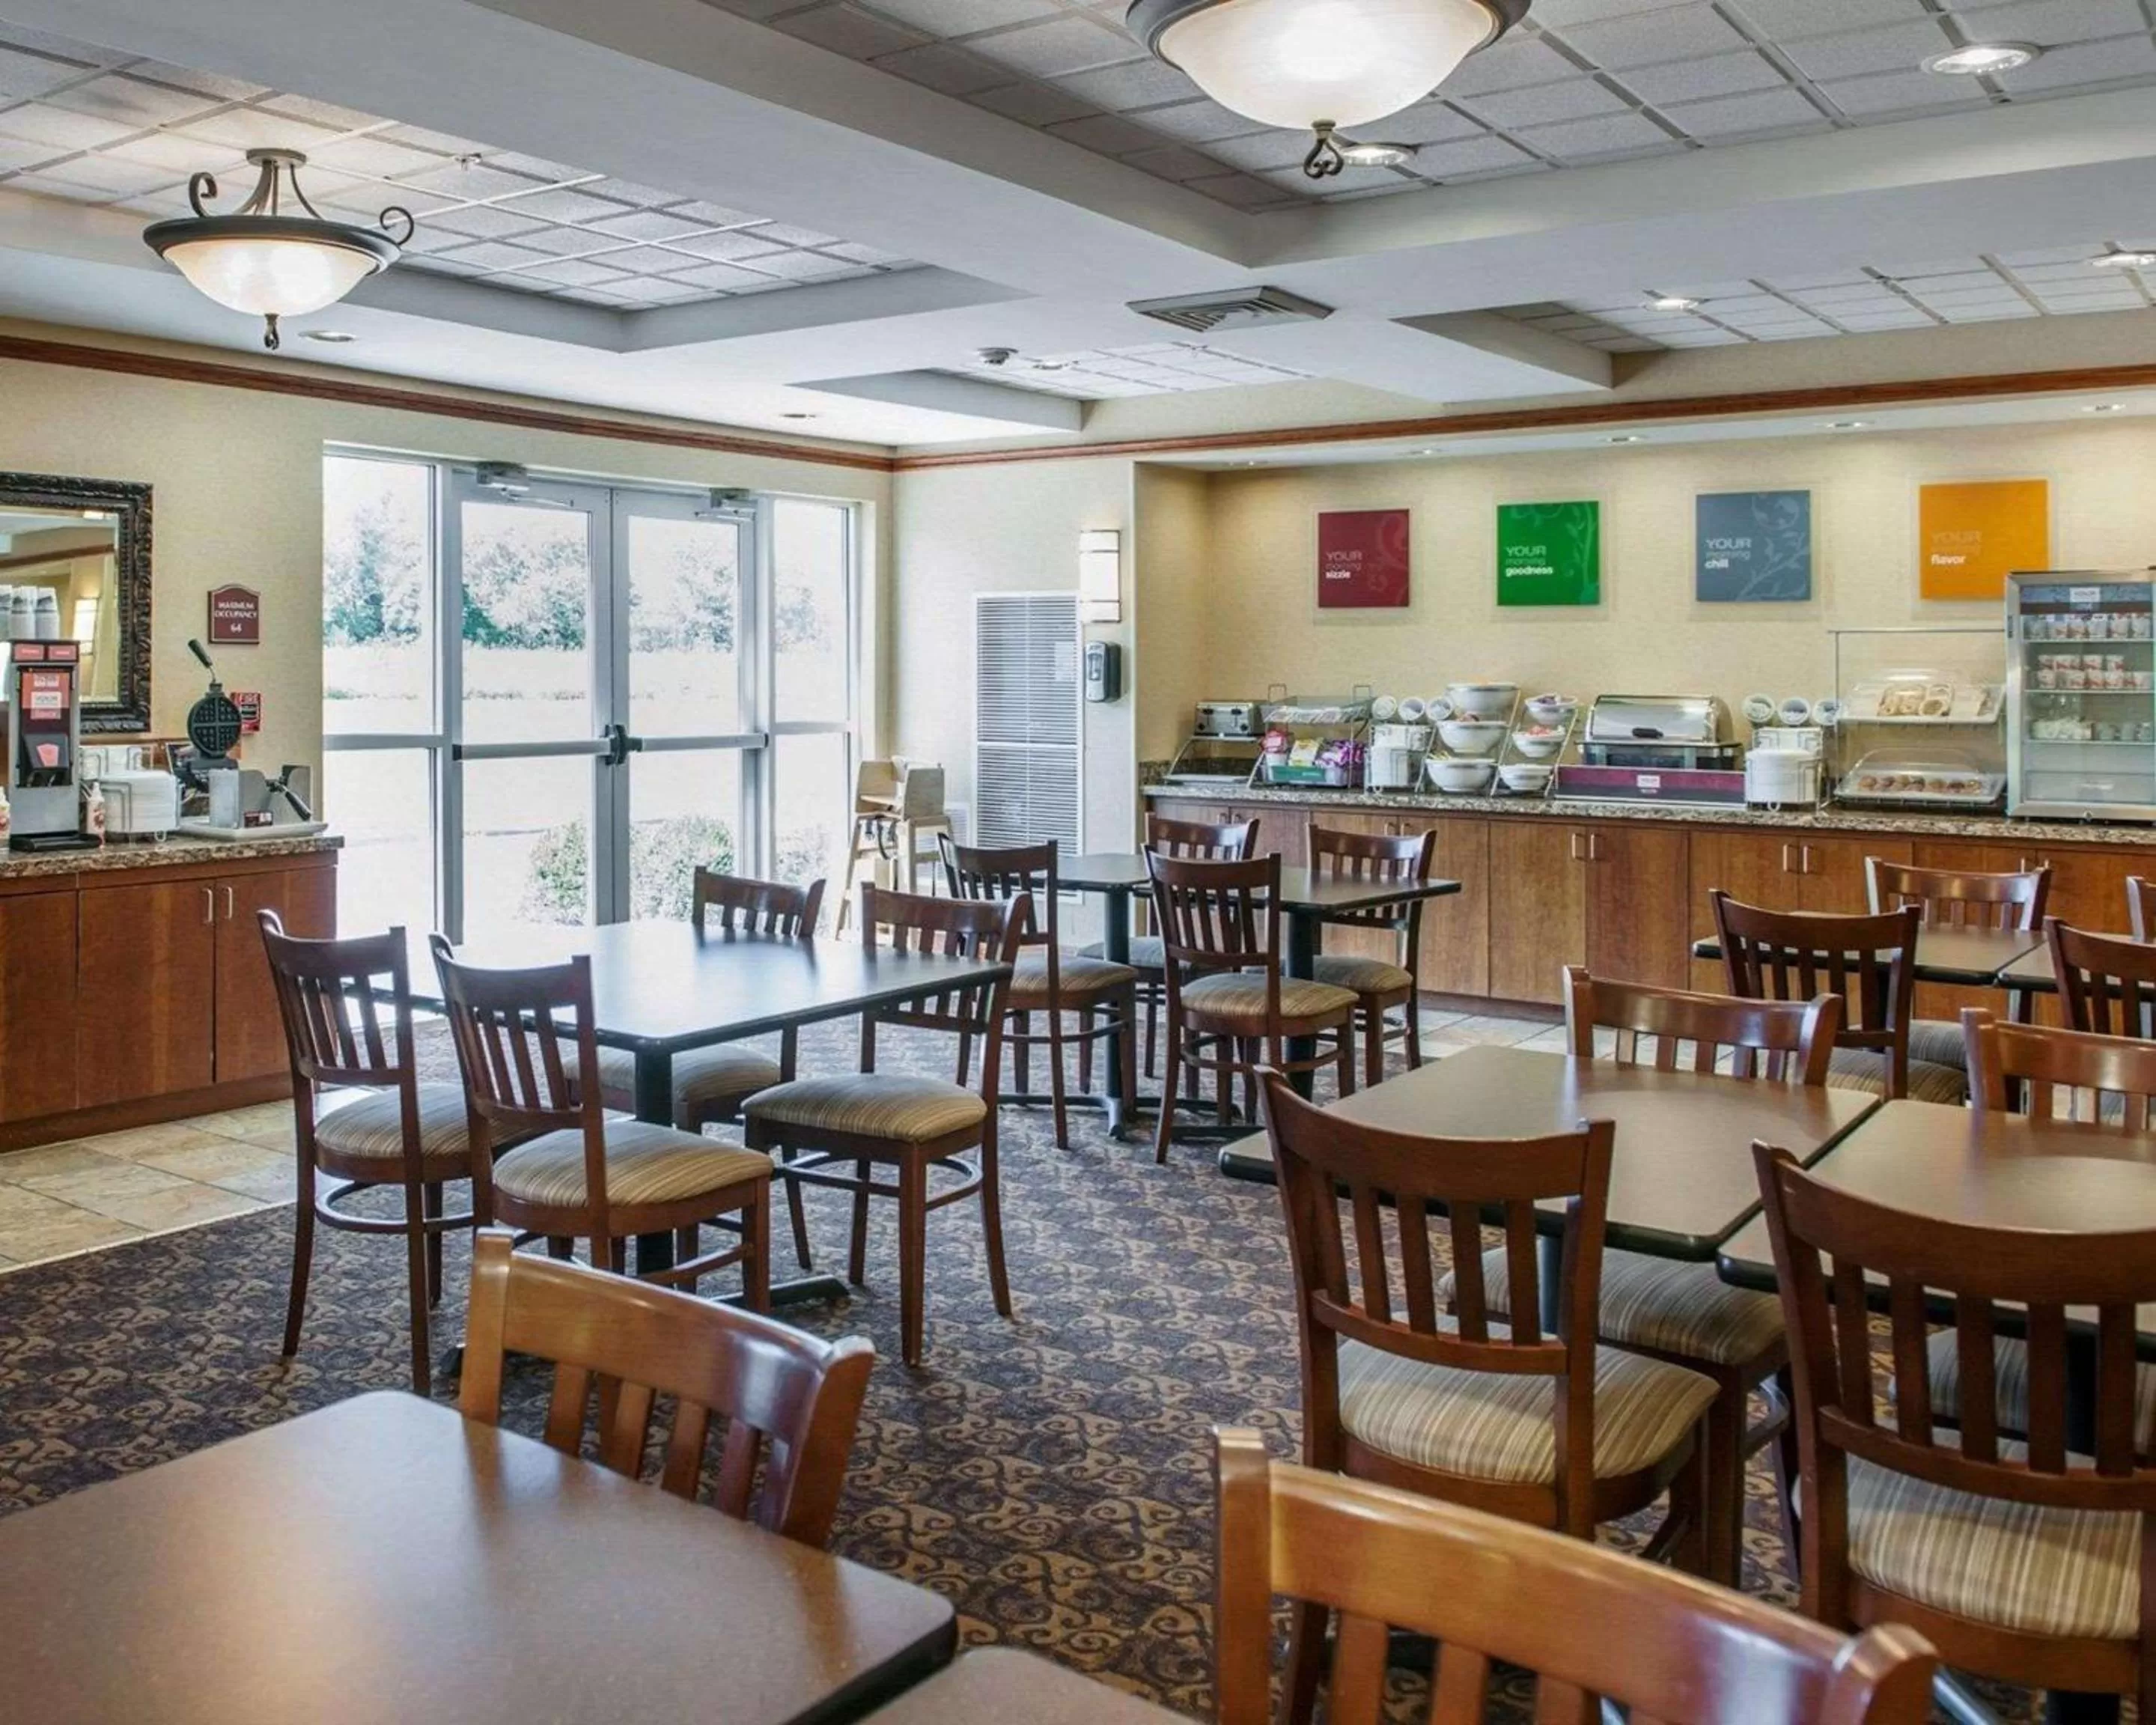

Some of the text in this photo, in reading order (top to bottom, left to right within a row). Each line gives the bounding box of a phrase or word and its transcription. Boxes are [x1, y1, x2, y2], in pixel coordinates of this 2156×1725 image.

[1705, 538, 1752, 550] YOUR
[1326, 550, 1362, 562] YOUR
[1505, 544, 1547, 557] YOUR
[1705, 559, 1729, 569] chill
[1931, 553, 1966, 565] flavor
[1326, 570, 1351, 579] sizzle
[1505, 566, 1553, 578] goodness
[214, 609, 257, 619] OCCUPANCY
